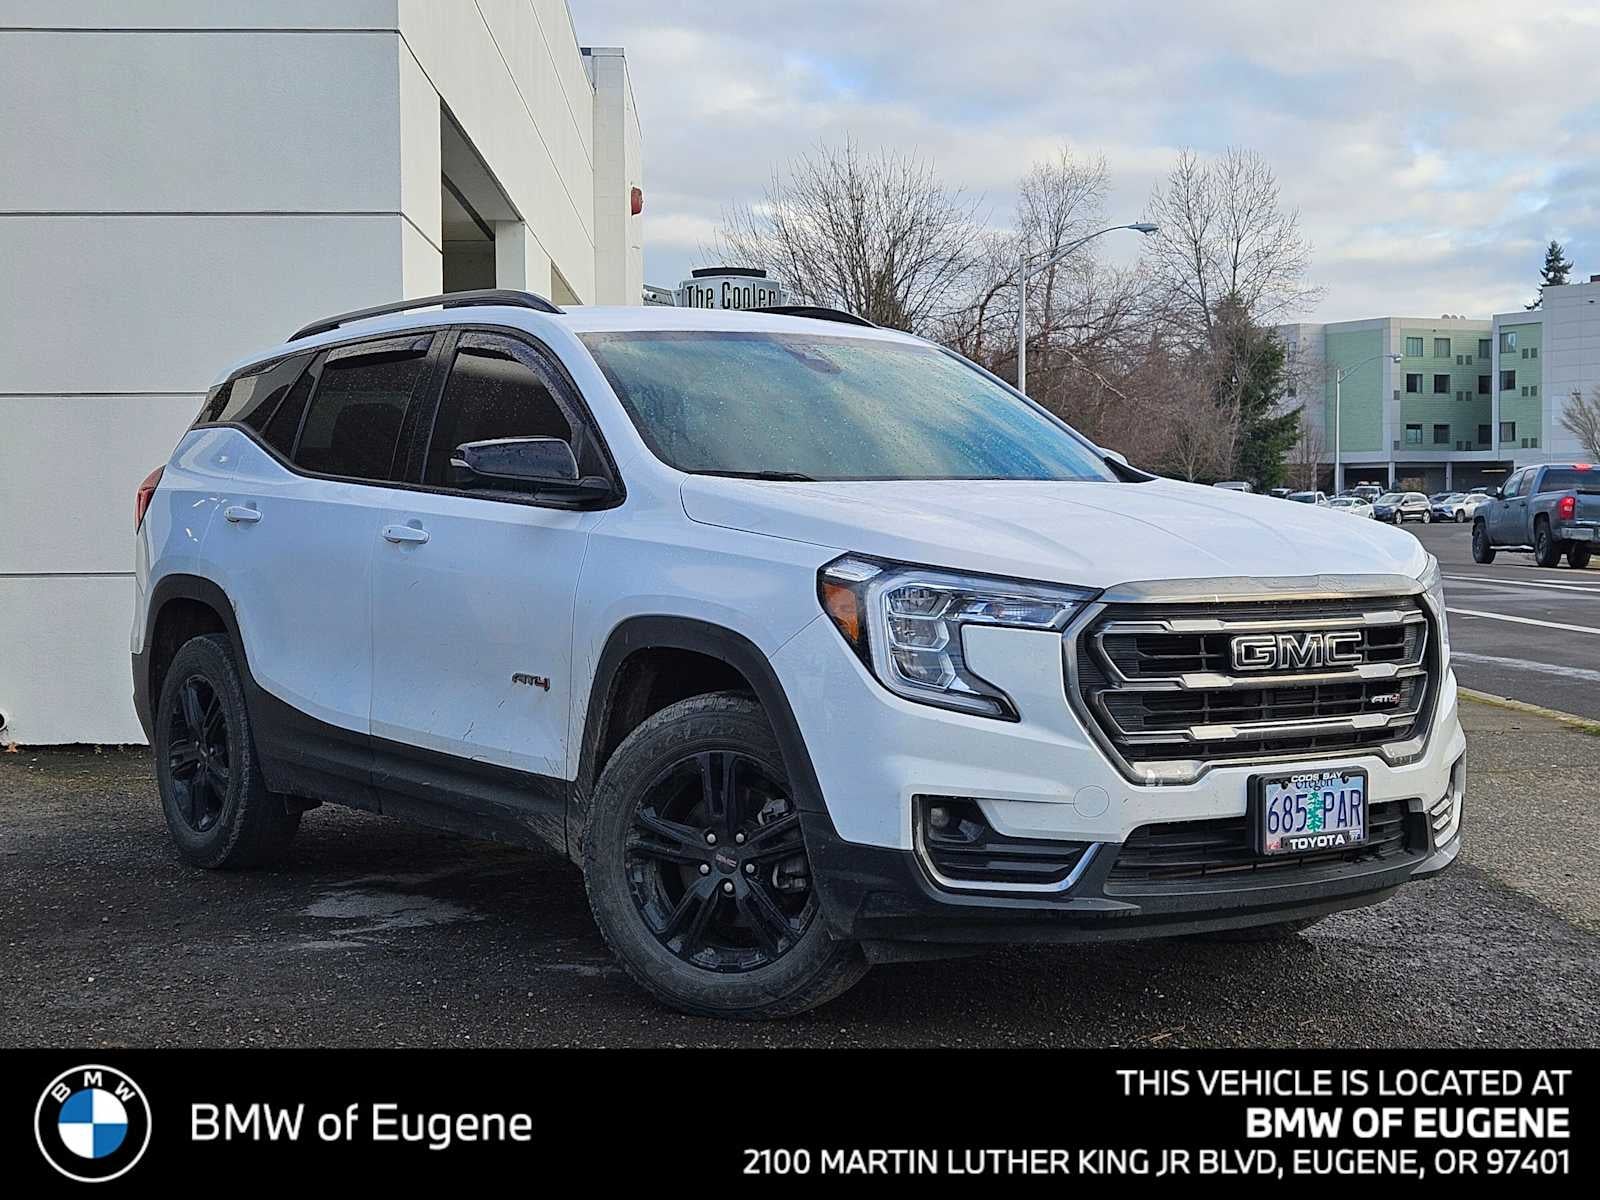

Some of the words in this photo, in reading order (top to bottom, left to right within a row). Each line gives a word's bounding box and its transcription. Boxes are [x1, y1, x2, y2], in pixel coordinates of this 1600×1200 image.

[686, 283, 714, 309] The
[721, 281, 776, 309] Cooler
[1231, 631, 1363, 671] GMC
[511, 672, 551, 692] AT4
[1323, 771, 1342, 781] BAY
[1268, 793, 1308, 834] 685
[1322, 789, 1361, 829] PAR
[1290, 834, 1345, 850] TOYOTA
